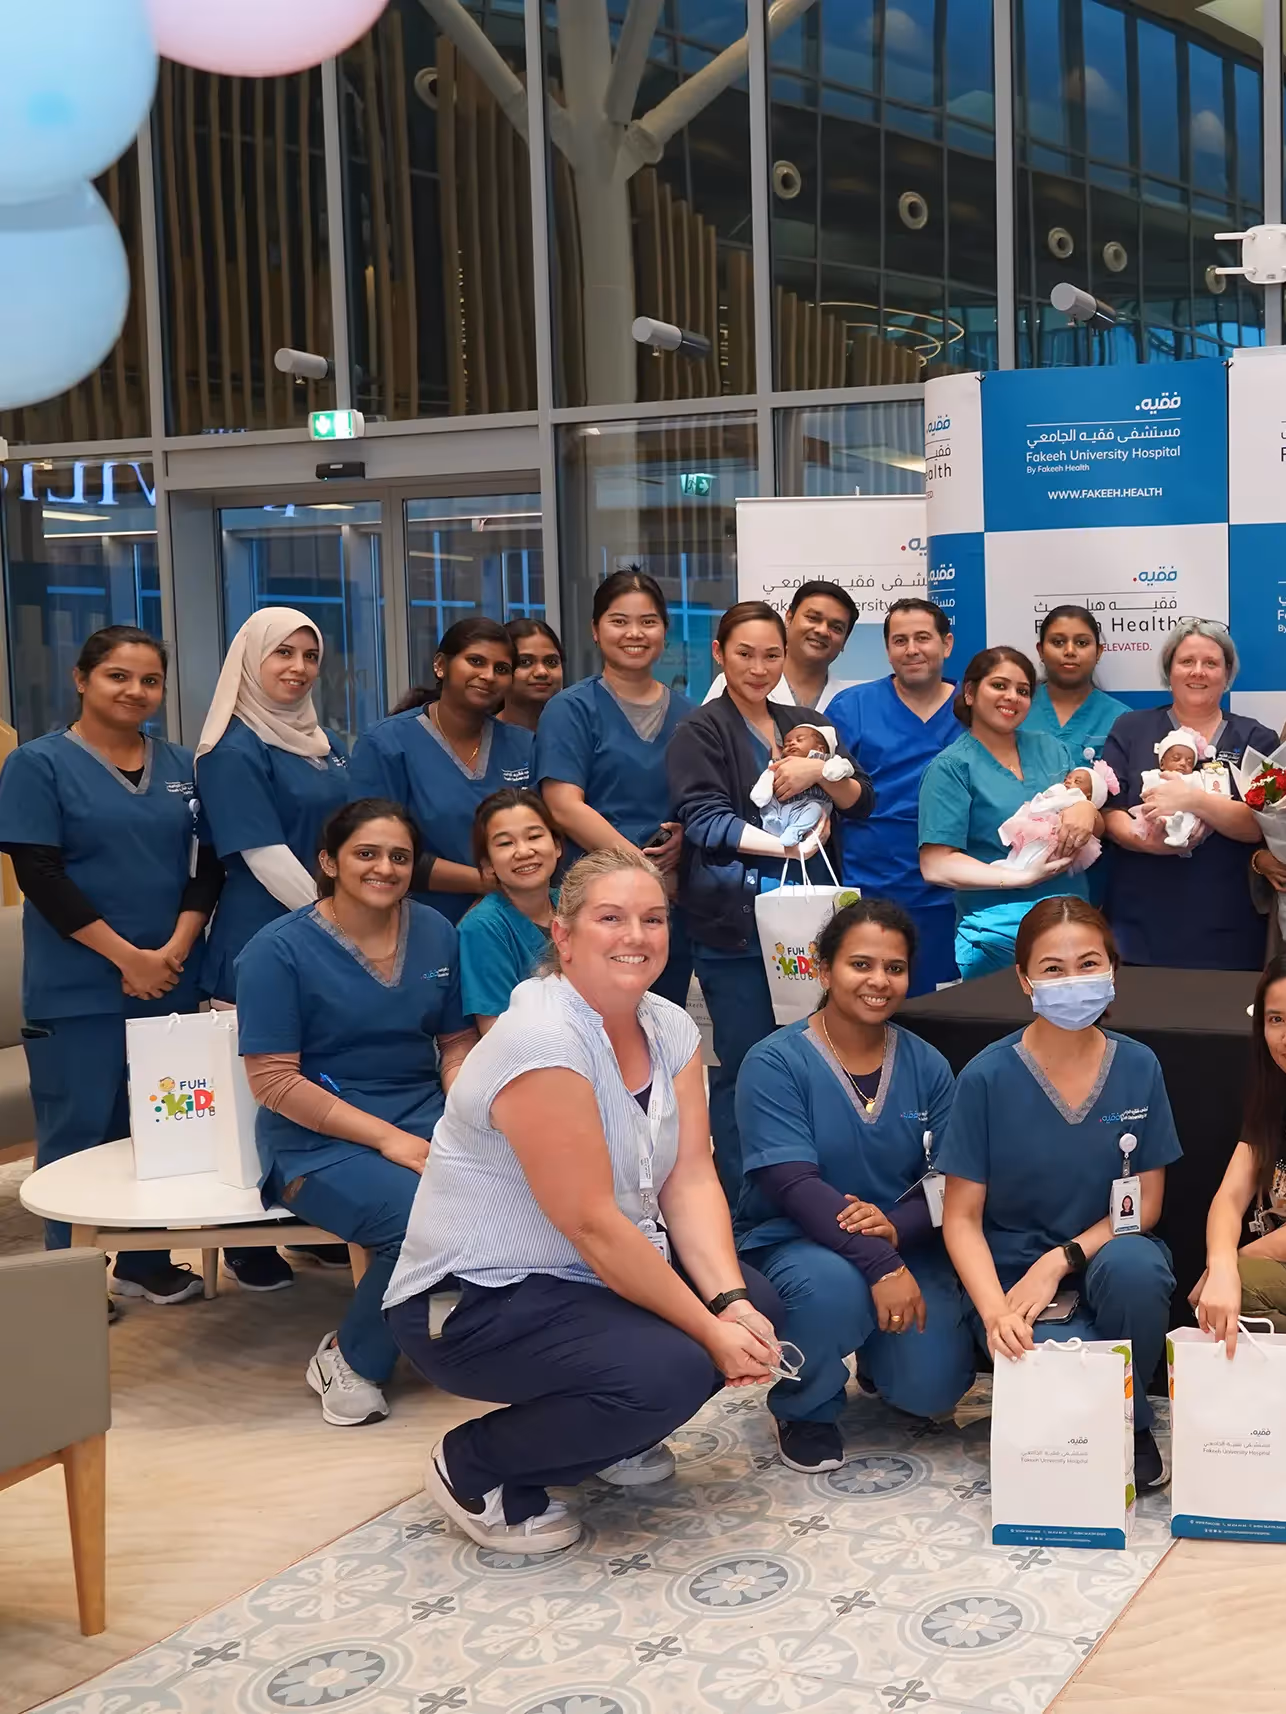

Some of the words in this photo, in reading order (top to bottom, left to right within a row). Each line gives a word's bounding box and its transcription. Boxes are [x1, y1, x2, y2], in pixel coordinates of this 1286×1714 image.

[1026, 429, 1076, 449] الجامعي
[1078, 428, 1115, 443] فقيه
[1117, 425, 1181, 443] مستشفى
[1026, 450, 1067, 463] Fakeeh
[1070, 448, 1129, 462] University
[1132, 445, 1181, 460] Hospital
[1026, 465, 1036, 475] By
[1037, 464, 1064, 473] Fakeeh
[1065, 463, 1090, 472] Health
[1047, 487, 1163, 500] WWW.FAKEEH.HEALTH
[1112, 616, 1177, 632] Health
[1102, 642, 1152, 652] ELEVATED.
[787, 947, 805, 955] FUH
[788, 972, 814, 980] CLUB
[180, 1078, 207, 1090] FUH
[174, 1107, 216, 1121] CLUB
